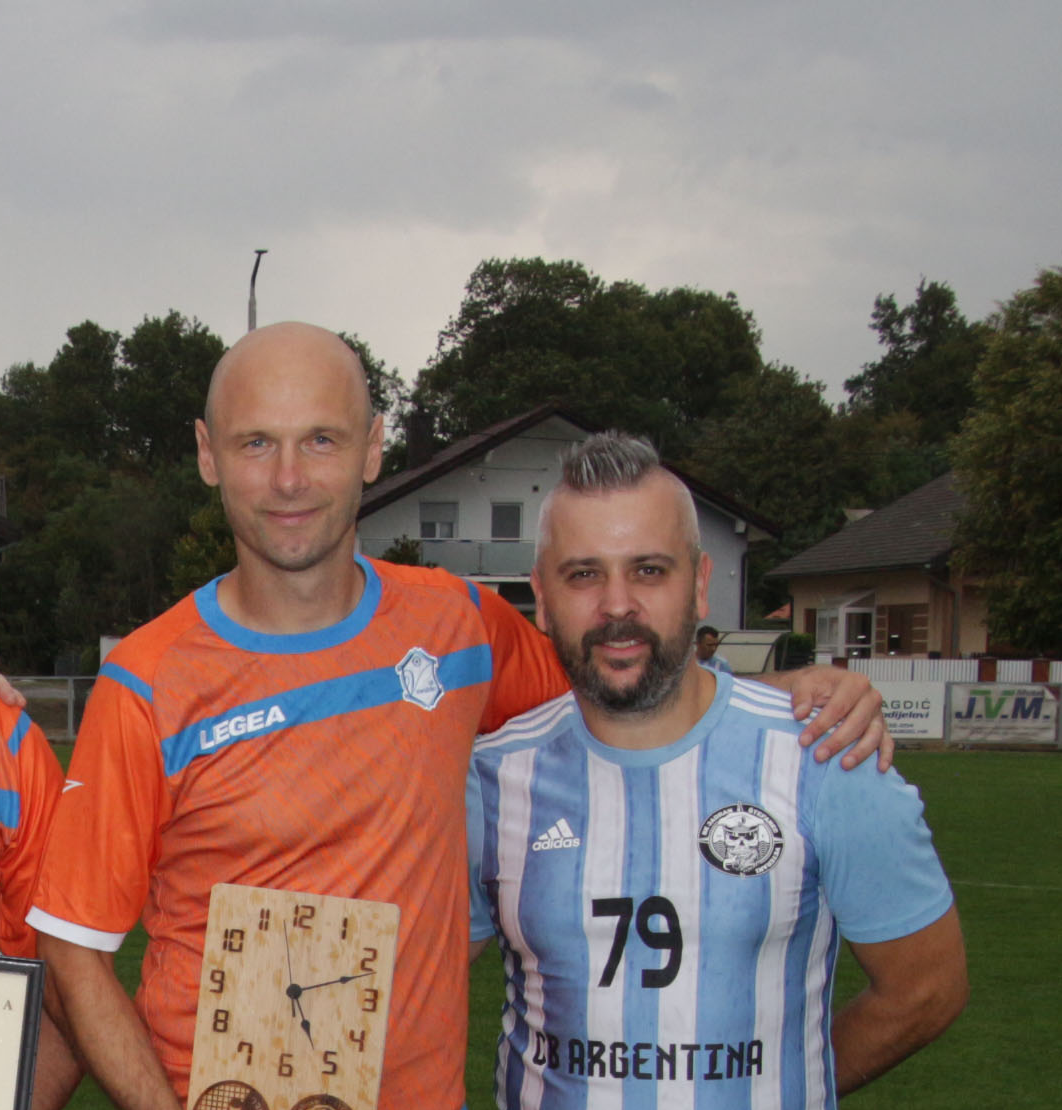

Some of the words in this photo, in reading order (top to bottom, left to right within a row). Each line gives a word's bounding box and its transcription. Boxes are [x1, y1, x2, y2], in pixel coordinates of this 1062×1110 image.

[200, 705, 286, 750] LEGEA
[532, 837, 581, 852] adidas
[258, 908, 270, 932] 11
[293, 904, 316, 929] 12
[341, 917, 348, 940] 1
[223, 928, 245, 953] 10
[591, 895, 683, 988] 79
[360, 947, 378, 972] 2
[209, 969, 226, 994] 9
[362, 988, 379, 1013] 3
[212, 1009, 229, 1033] 8
[349, 1029, 365, 1052] 4
[237, 1041, 254, 1066] 7
[278, 1053, 294, 1078] 6
[322, 1051, 338, 1075] 5
[568, 1038, 763, 1081] ARGENTINA
